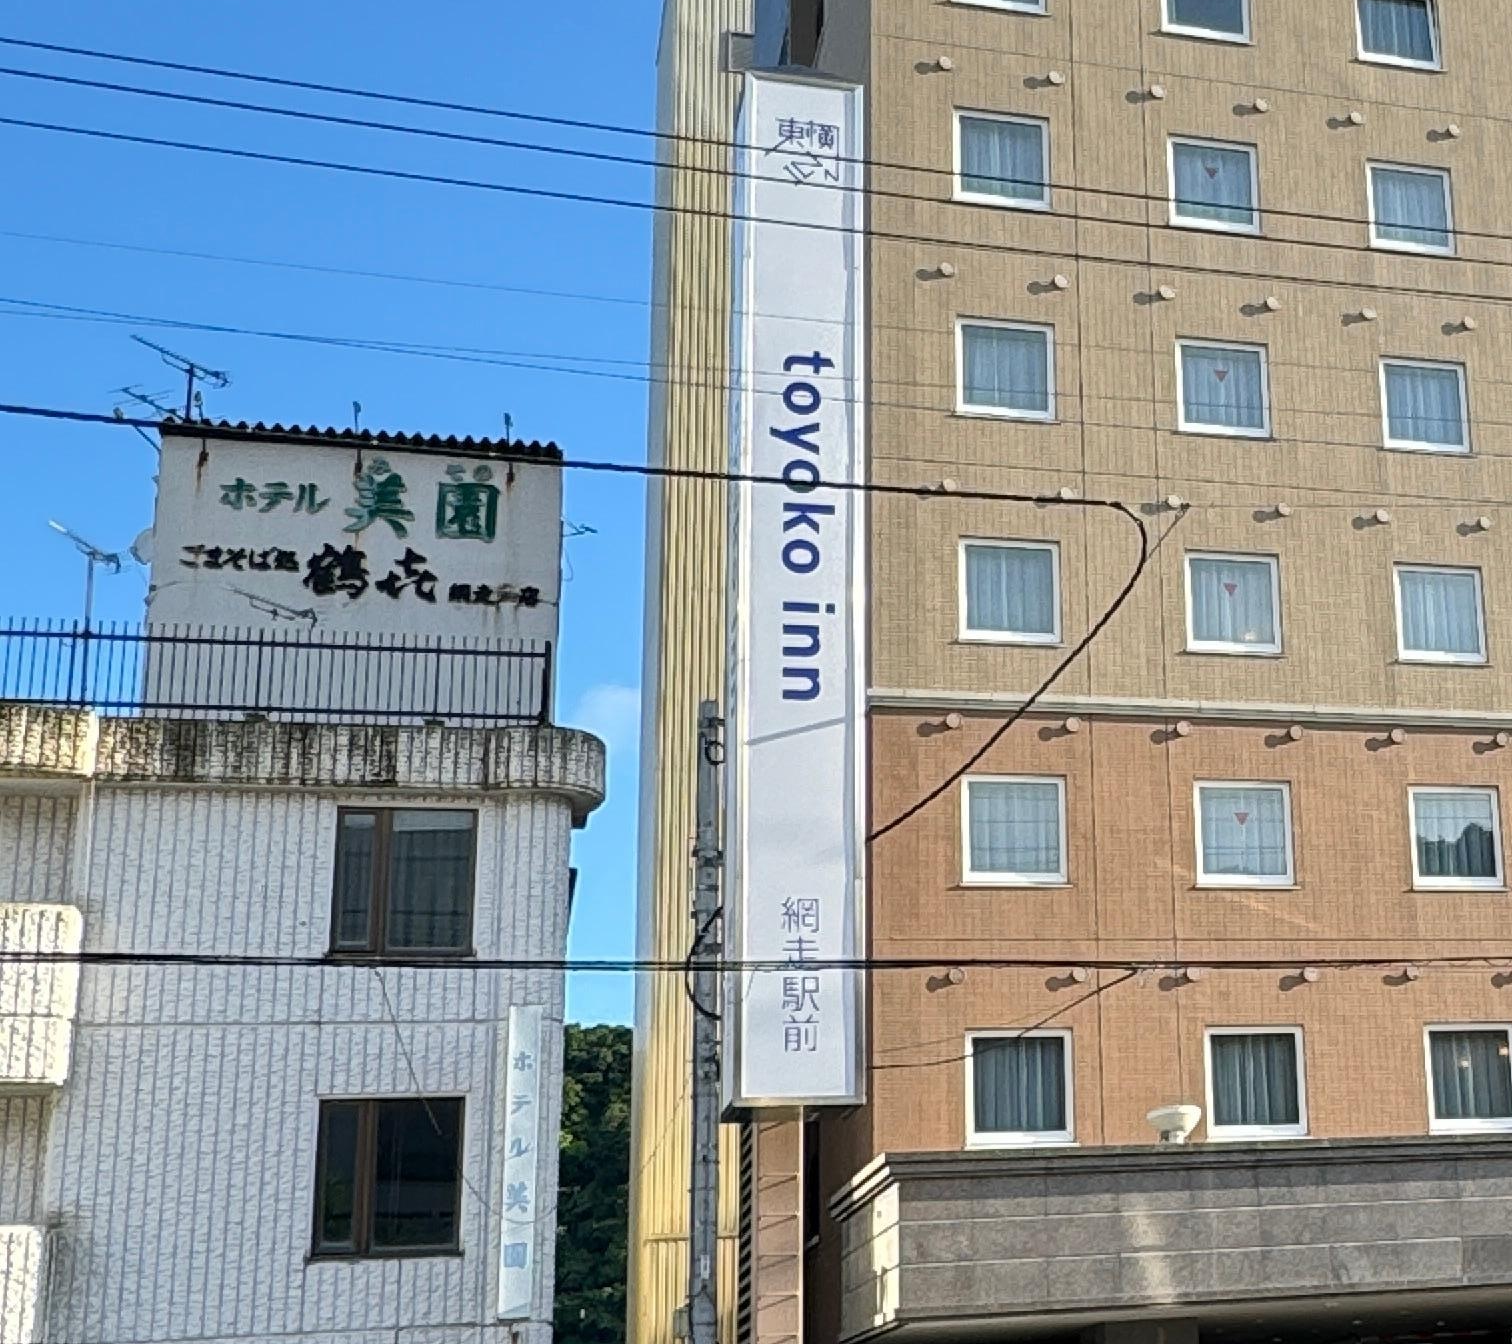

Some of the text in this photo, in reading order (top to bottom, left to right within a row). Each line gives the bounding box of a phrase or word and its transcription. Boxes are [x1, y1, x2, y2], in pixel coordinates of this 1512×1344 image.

[219, 477, 331, 514] ホテル
[770, 350, 836, 702] toyoko inn
[781, 896, 821, 1053] 網走駅前
